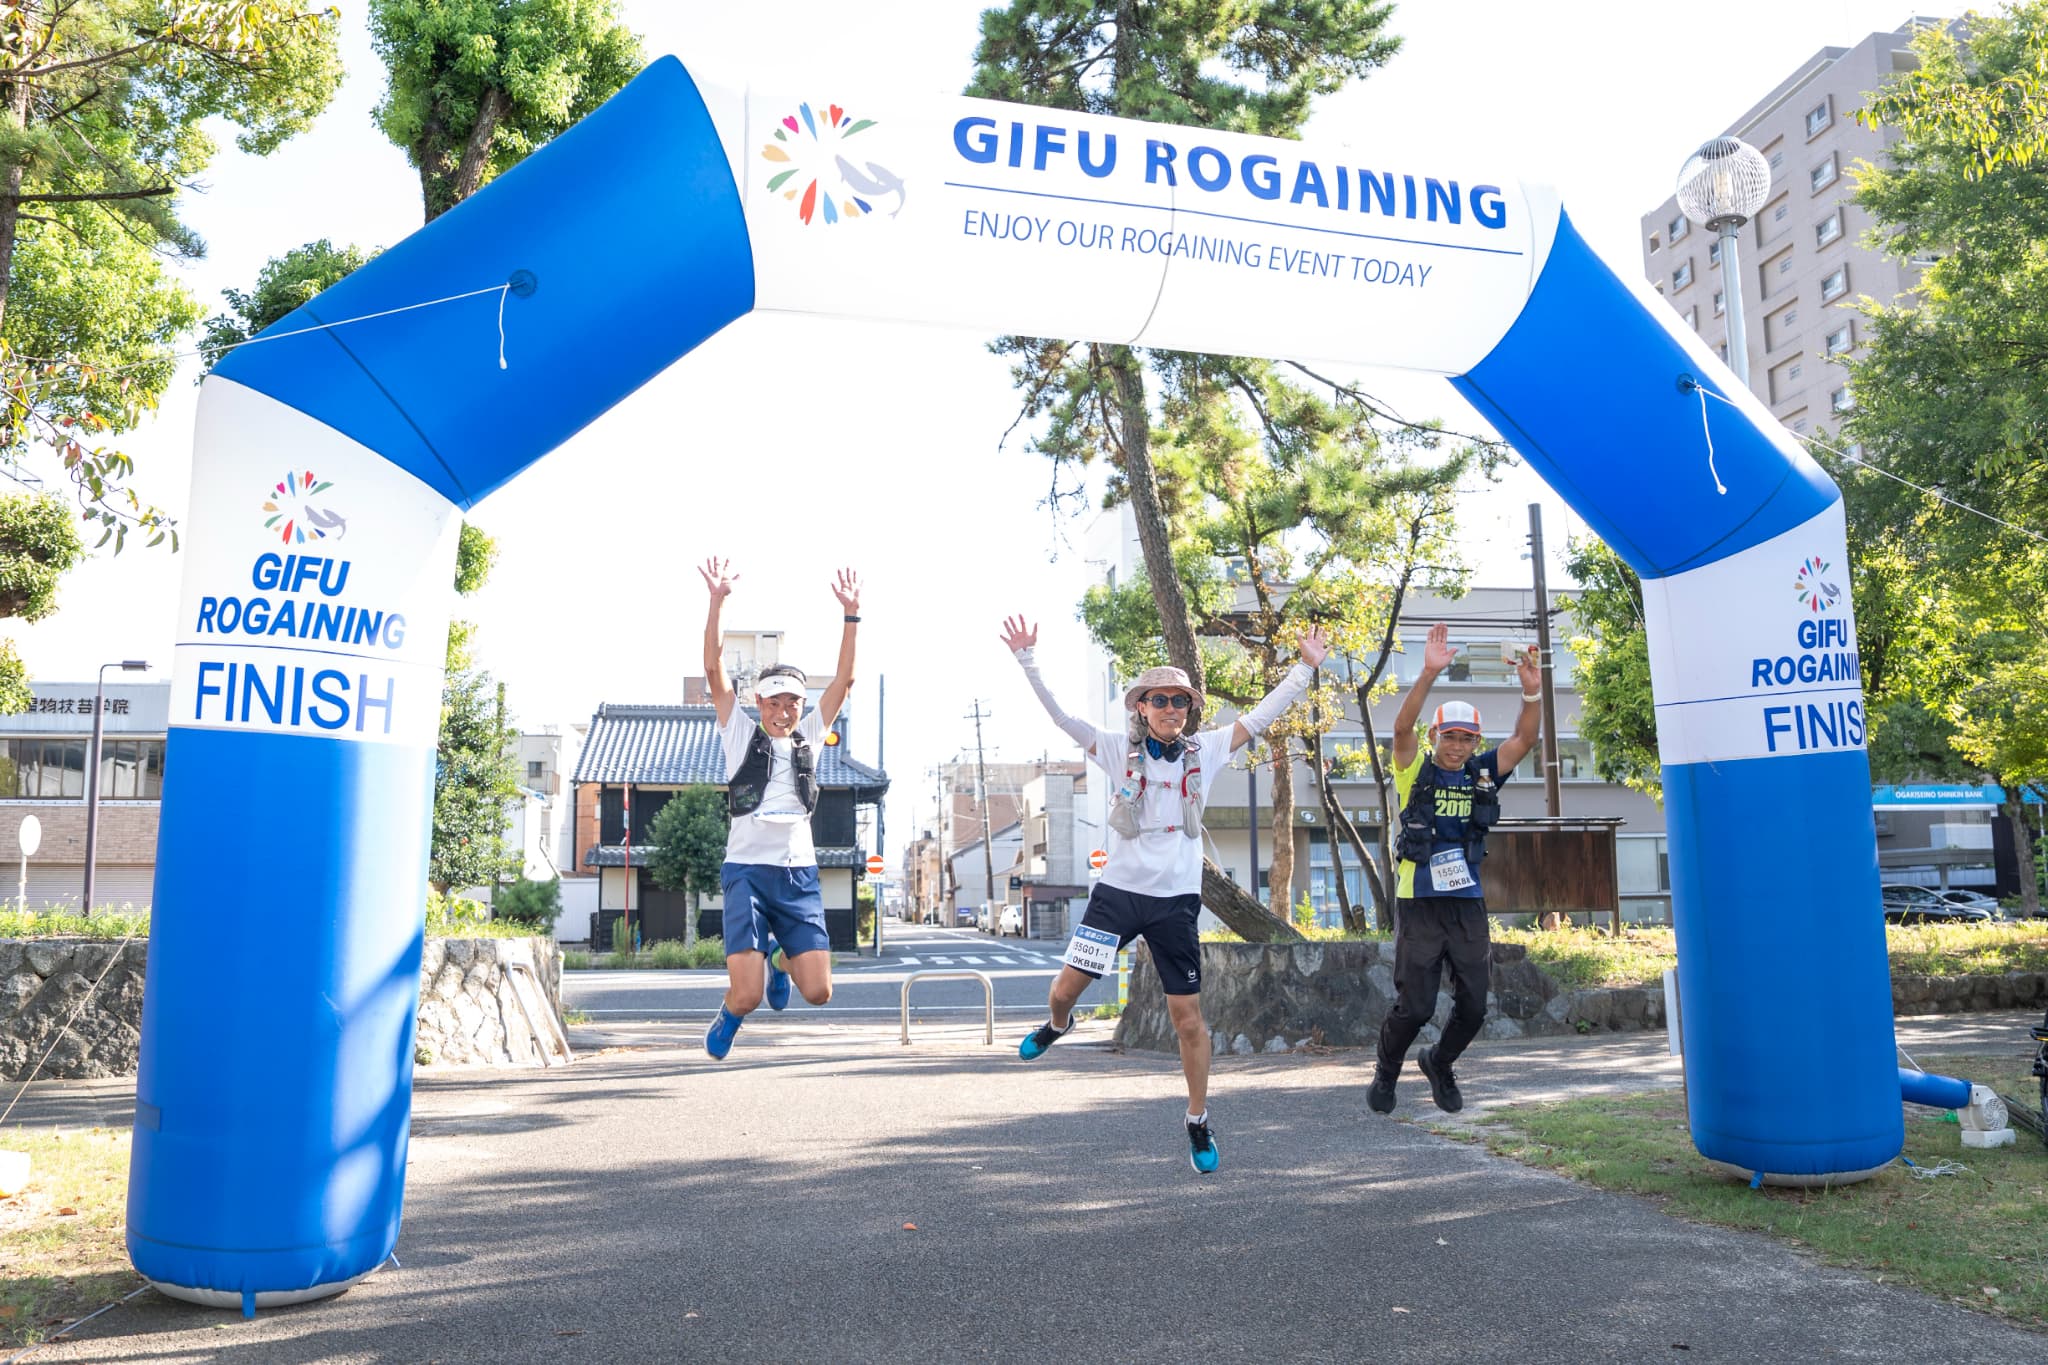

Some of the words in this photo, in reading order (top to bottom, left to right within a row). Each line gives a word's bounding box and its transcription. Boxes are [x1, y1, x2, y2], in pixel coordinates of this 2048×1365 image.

[953, 116, 1117, 178] GIFU
[1145, 139, 1506, 230] ROGAINING
[963, 210, 1051, 243] ENJOY
[1057, 221, 1114, 250] OUR
[1121, 227, 1262, 268] ROGAINING
[1268, 246, 1346, 278] EVENT
[1351, 256, 1433, 288] TODAY
[252, 552, 351, 597] GIFU
[196, 596, 407, 650] ROGAINING
[1797, 619, 1848, 650] GIFU
[195, 661, 395, 734] FINISH
[1434, 799, 1472, 818] 2016
[1895, 790, 1937, 799] OGAKISEINO
[1937, 790, 1964, 799] SHINKIN
[1964, 790, 1983, 799] BANK
